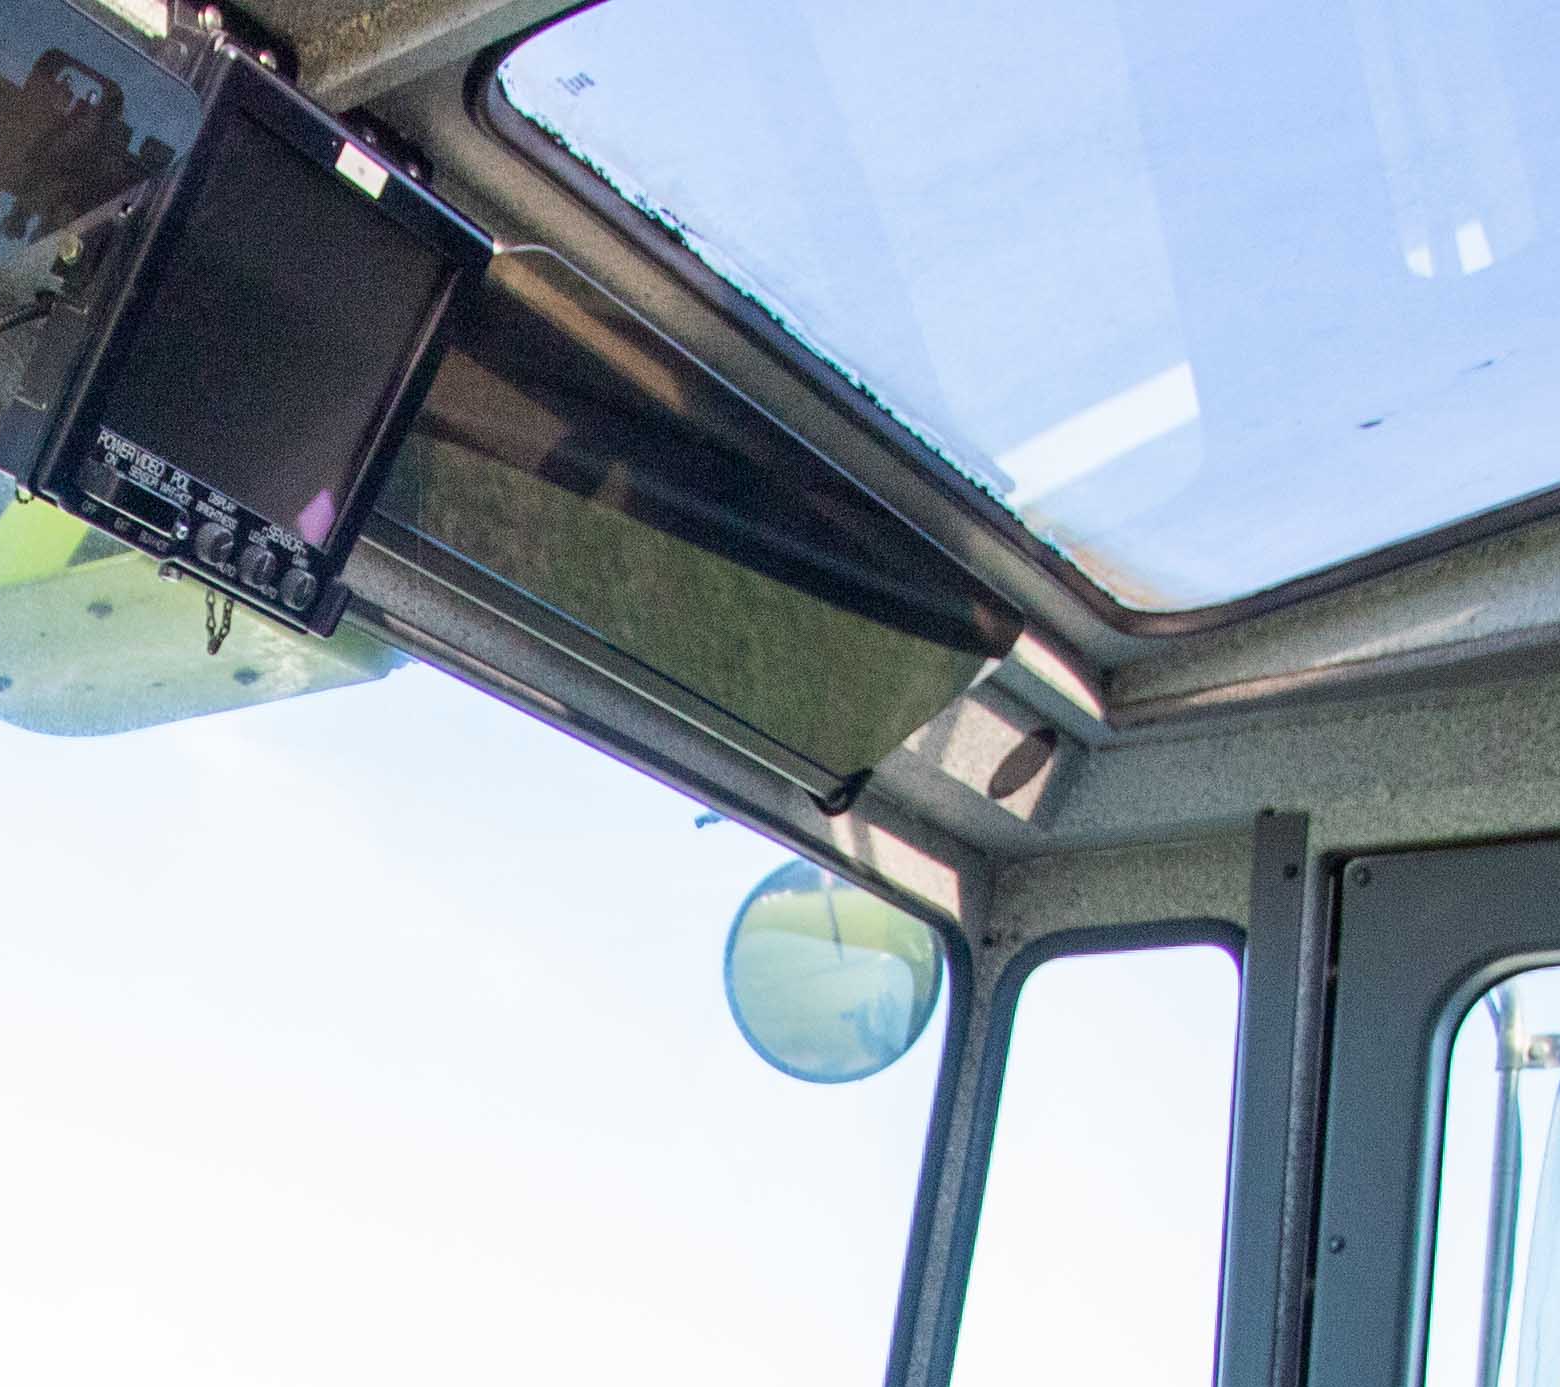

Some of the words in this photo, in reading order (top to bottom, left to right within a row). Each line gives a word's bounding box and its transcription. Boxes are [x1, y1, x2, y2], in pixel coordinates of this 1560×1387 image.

[97, 431, 136, 462] POWER
[136, 454, 165, 476] VIDEO
[171, 471, 192, 491] POL
[195, 501, 238, 531] BRIGHTNESS
[269, 525, 304, 552] SENSOR
